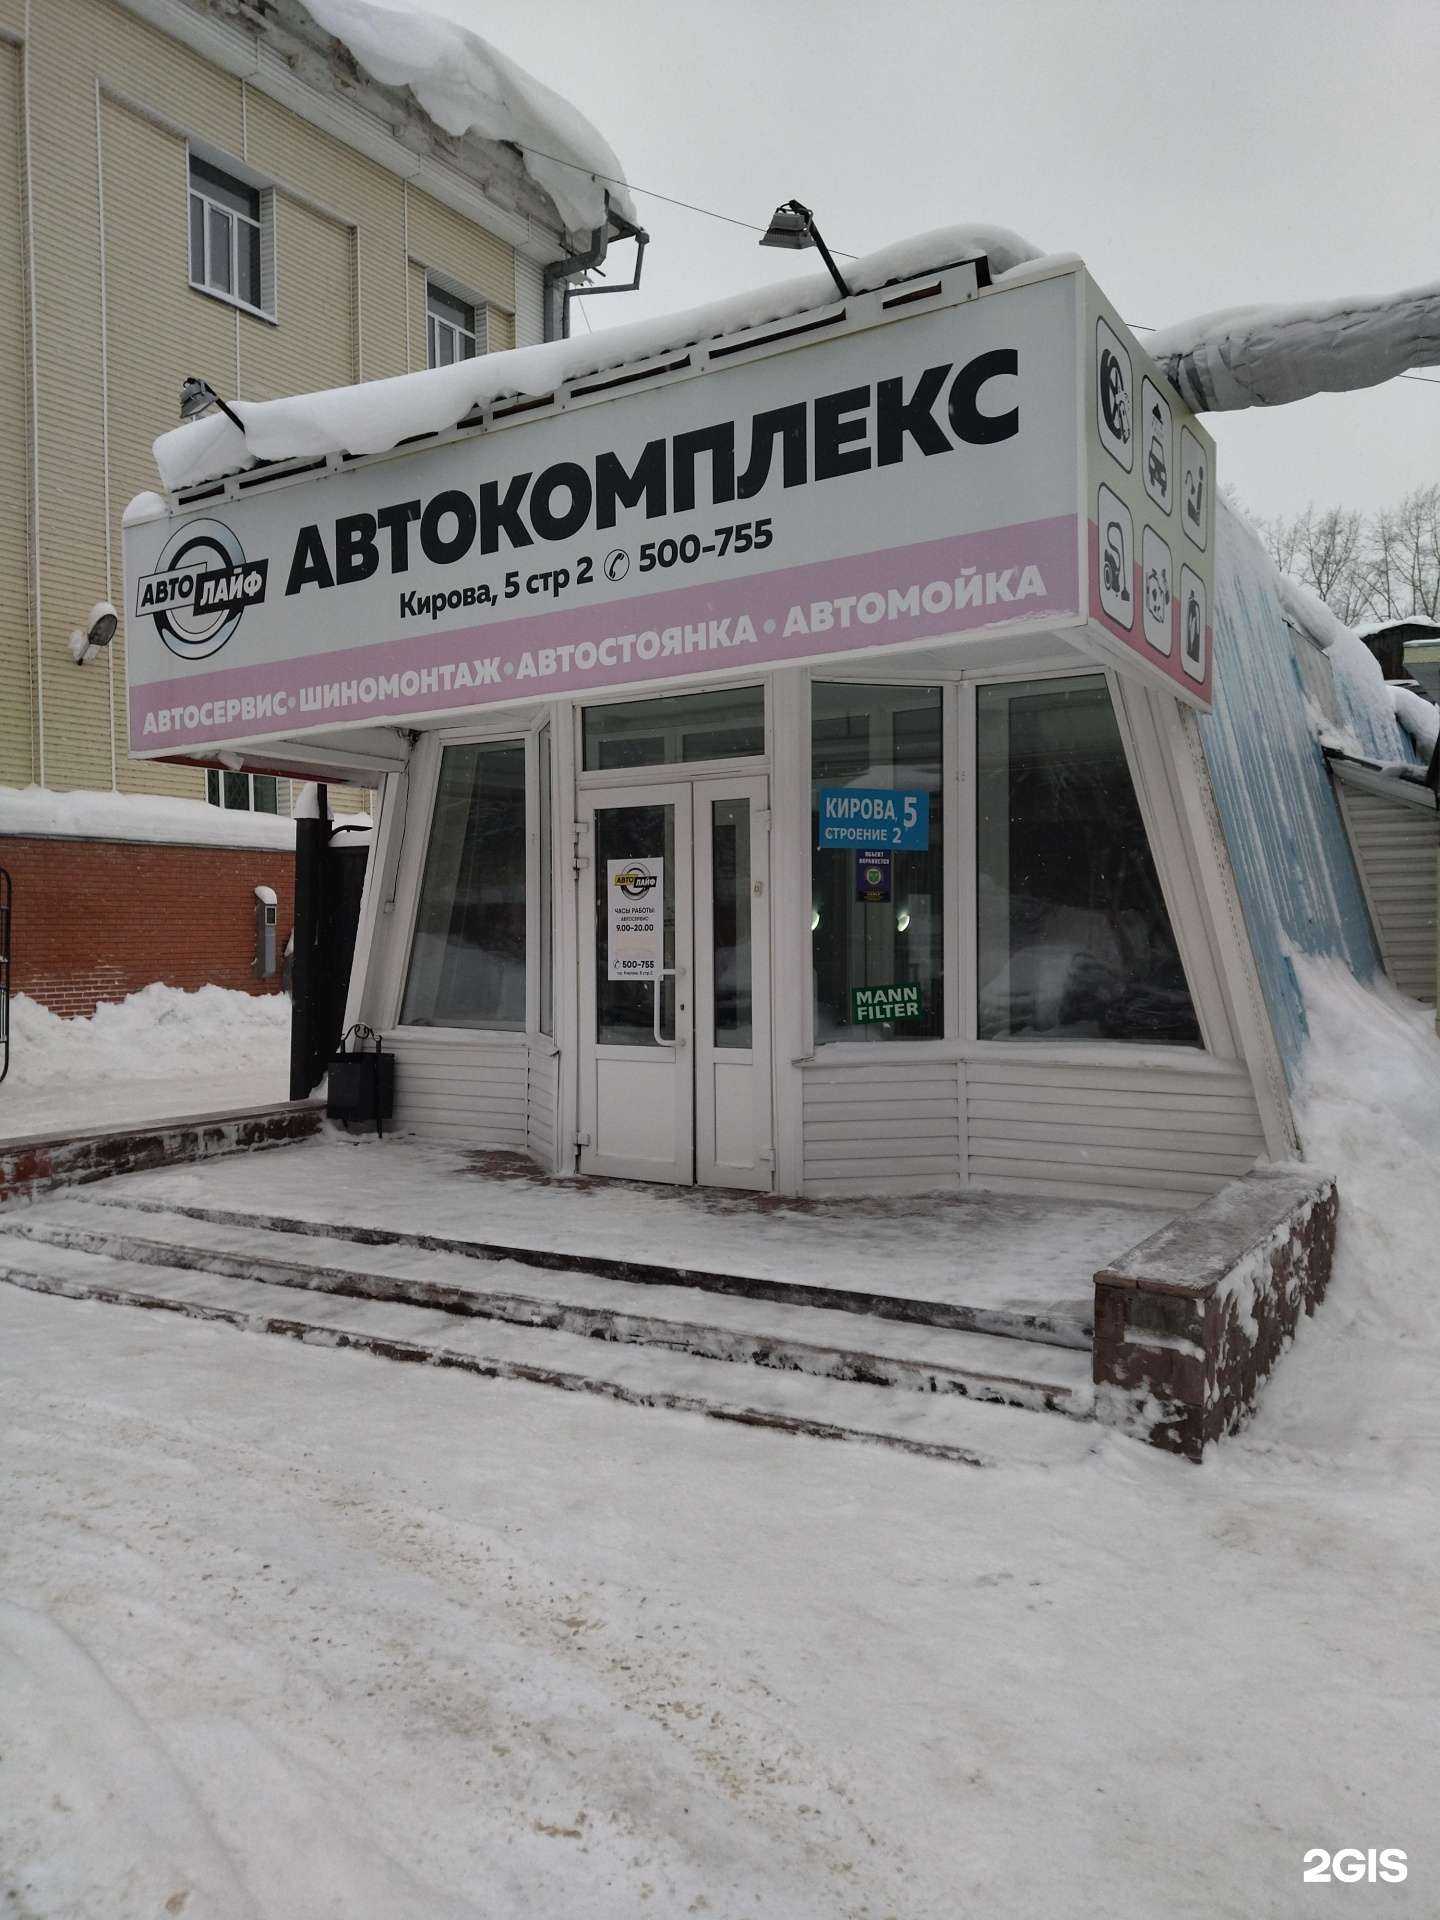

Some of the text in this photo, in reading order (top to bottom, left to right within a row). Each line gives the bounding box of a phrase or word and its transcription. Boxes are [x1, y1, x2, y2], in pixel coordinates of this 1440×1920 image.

[285, 349, 1019, 596] АВТОКОМПЛЕКС
[400, 518, 773, 619] Кирова, 5 стр 2 500-755
[141, 568, 263, 607] АВТО ЛАЙФ
[143, 565, 1048, 735] АВТОСЕРВИС ШИНОМОНТАЖ АВТОСТОЯНКА АВТОМОЙКА
[825, 796, 918, 828] КИРОВА, 5
[825, 827, 902, 843] СТРОЕНИЕ 2
[622, 960, 655, 969] 500-755
[856, 987, 918, 1005] MANN
[857, 1002, 919, 1021] FILTER
